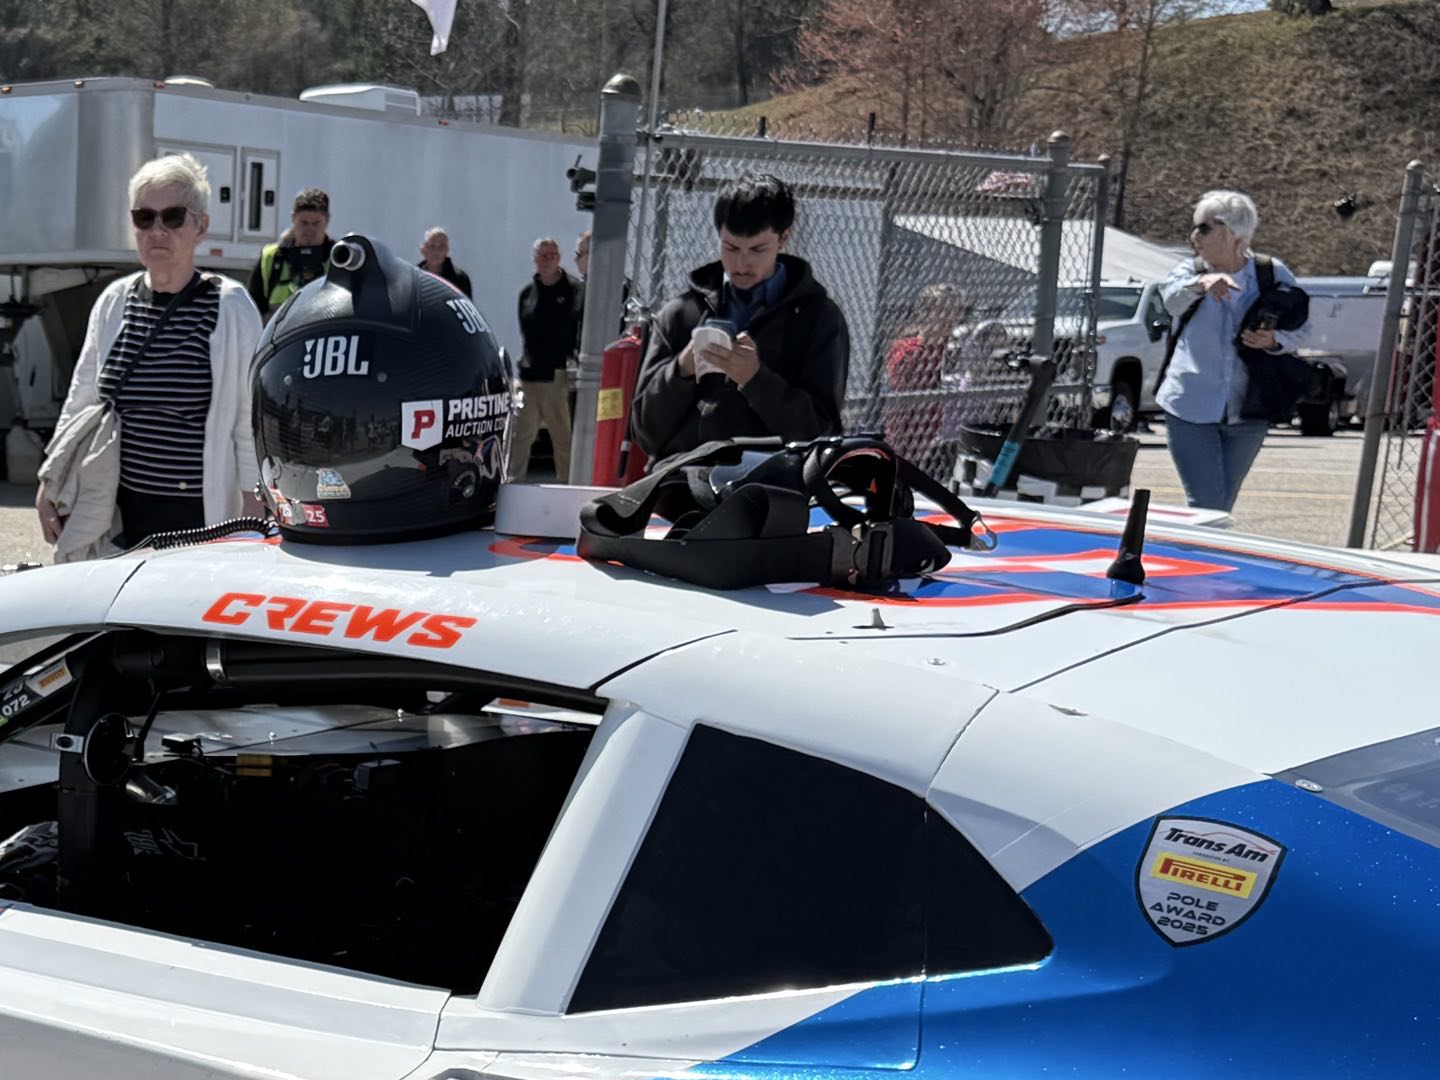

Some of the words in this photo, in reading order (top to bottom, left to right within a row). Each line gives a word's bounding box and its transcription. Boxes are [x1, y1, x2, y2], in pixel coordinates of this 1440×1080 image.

[303, 335, 370, 380] JBL
[447, 391, 511, 422] PRISTINE
[410, 409, 436, 440] P
[444, 419, 494, 439] AUCTION
[306, 510, 326, 523] 25
[202, 592, 478, 649] CREWS
[1, 694, 31, 717] 072
[1164, 827, 1227, 852] Trans
[1225, 843, 1269, 863] Am
[1159, 857, 1247, 892] PIRELLI
[1149, 902, 1226, 926] AWARD
[1166, 892, 1220, 911] POLE
[1157, 916, 1209, 936] 2025
